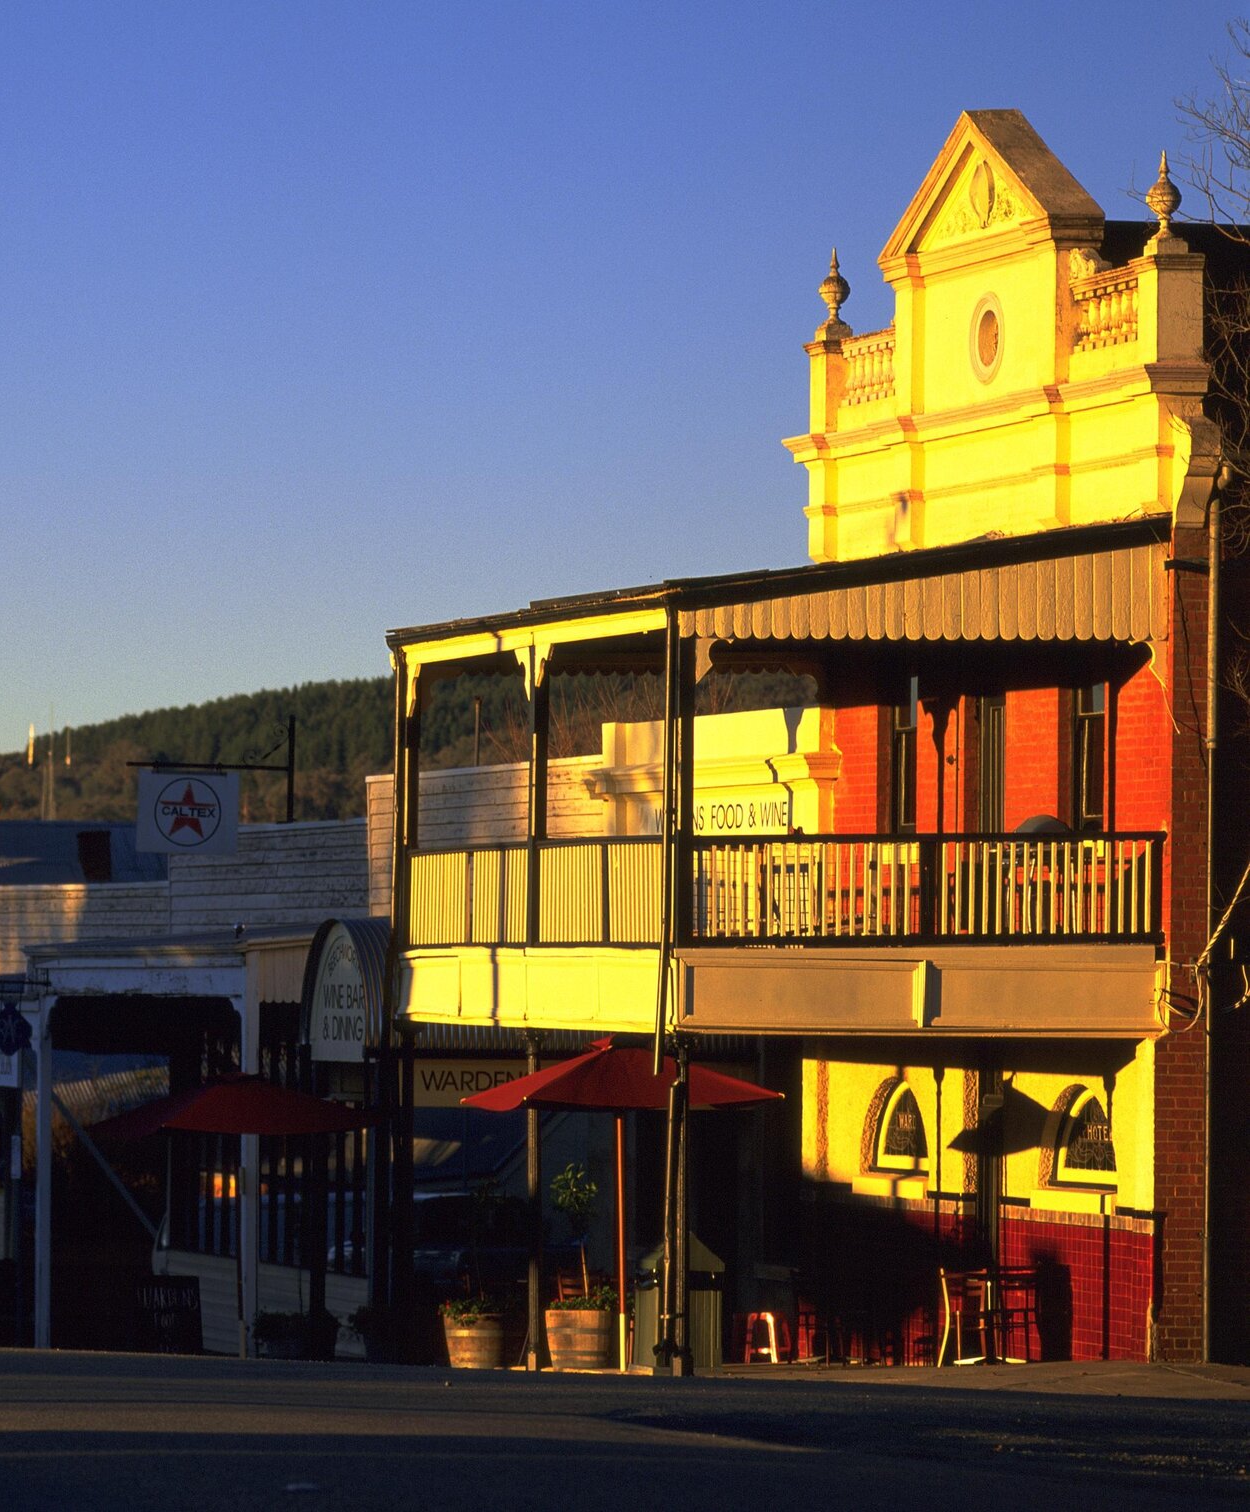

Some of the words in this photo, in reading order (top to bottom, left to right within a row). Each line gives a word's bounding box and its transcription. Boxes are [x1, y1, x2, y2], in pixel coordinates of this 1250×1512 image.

[161, 806, 216, 818] CALTEX
[711, 804, 743, 830] FOOD
[748, 803, 756, 828] &
[760, 801, 787, 827] WINE
[323, 984, 344, 1009] WINE
[347, 984, 364, 1009] BAR
[323, 1015, 330, 1041] &
[333, 1015, 363, 1041] DINING
[421, 1070, 530, 1092] WARDE
